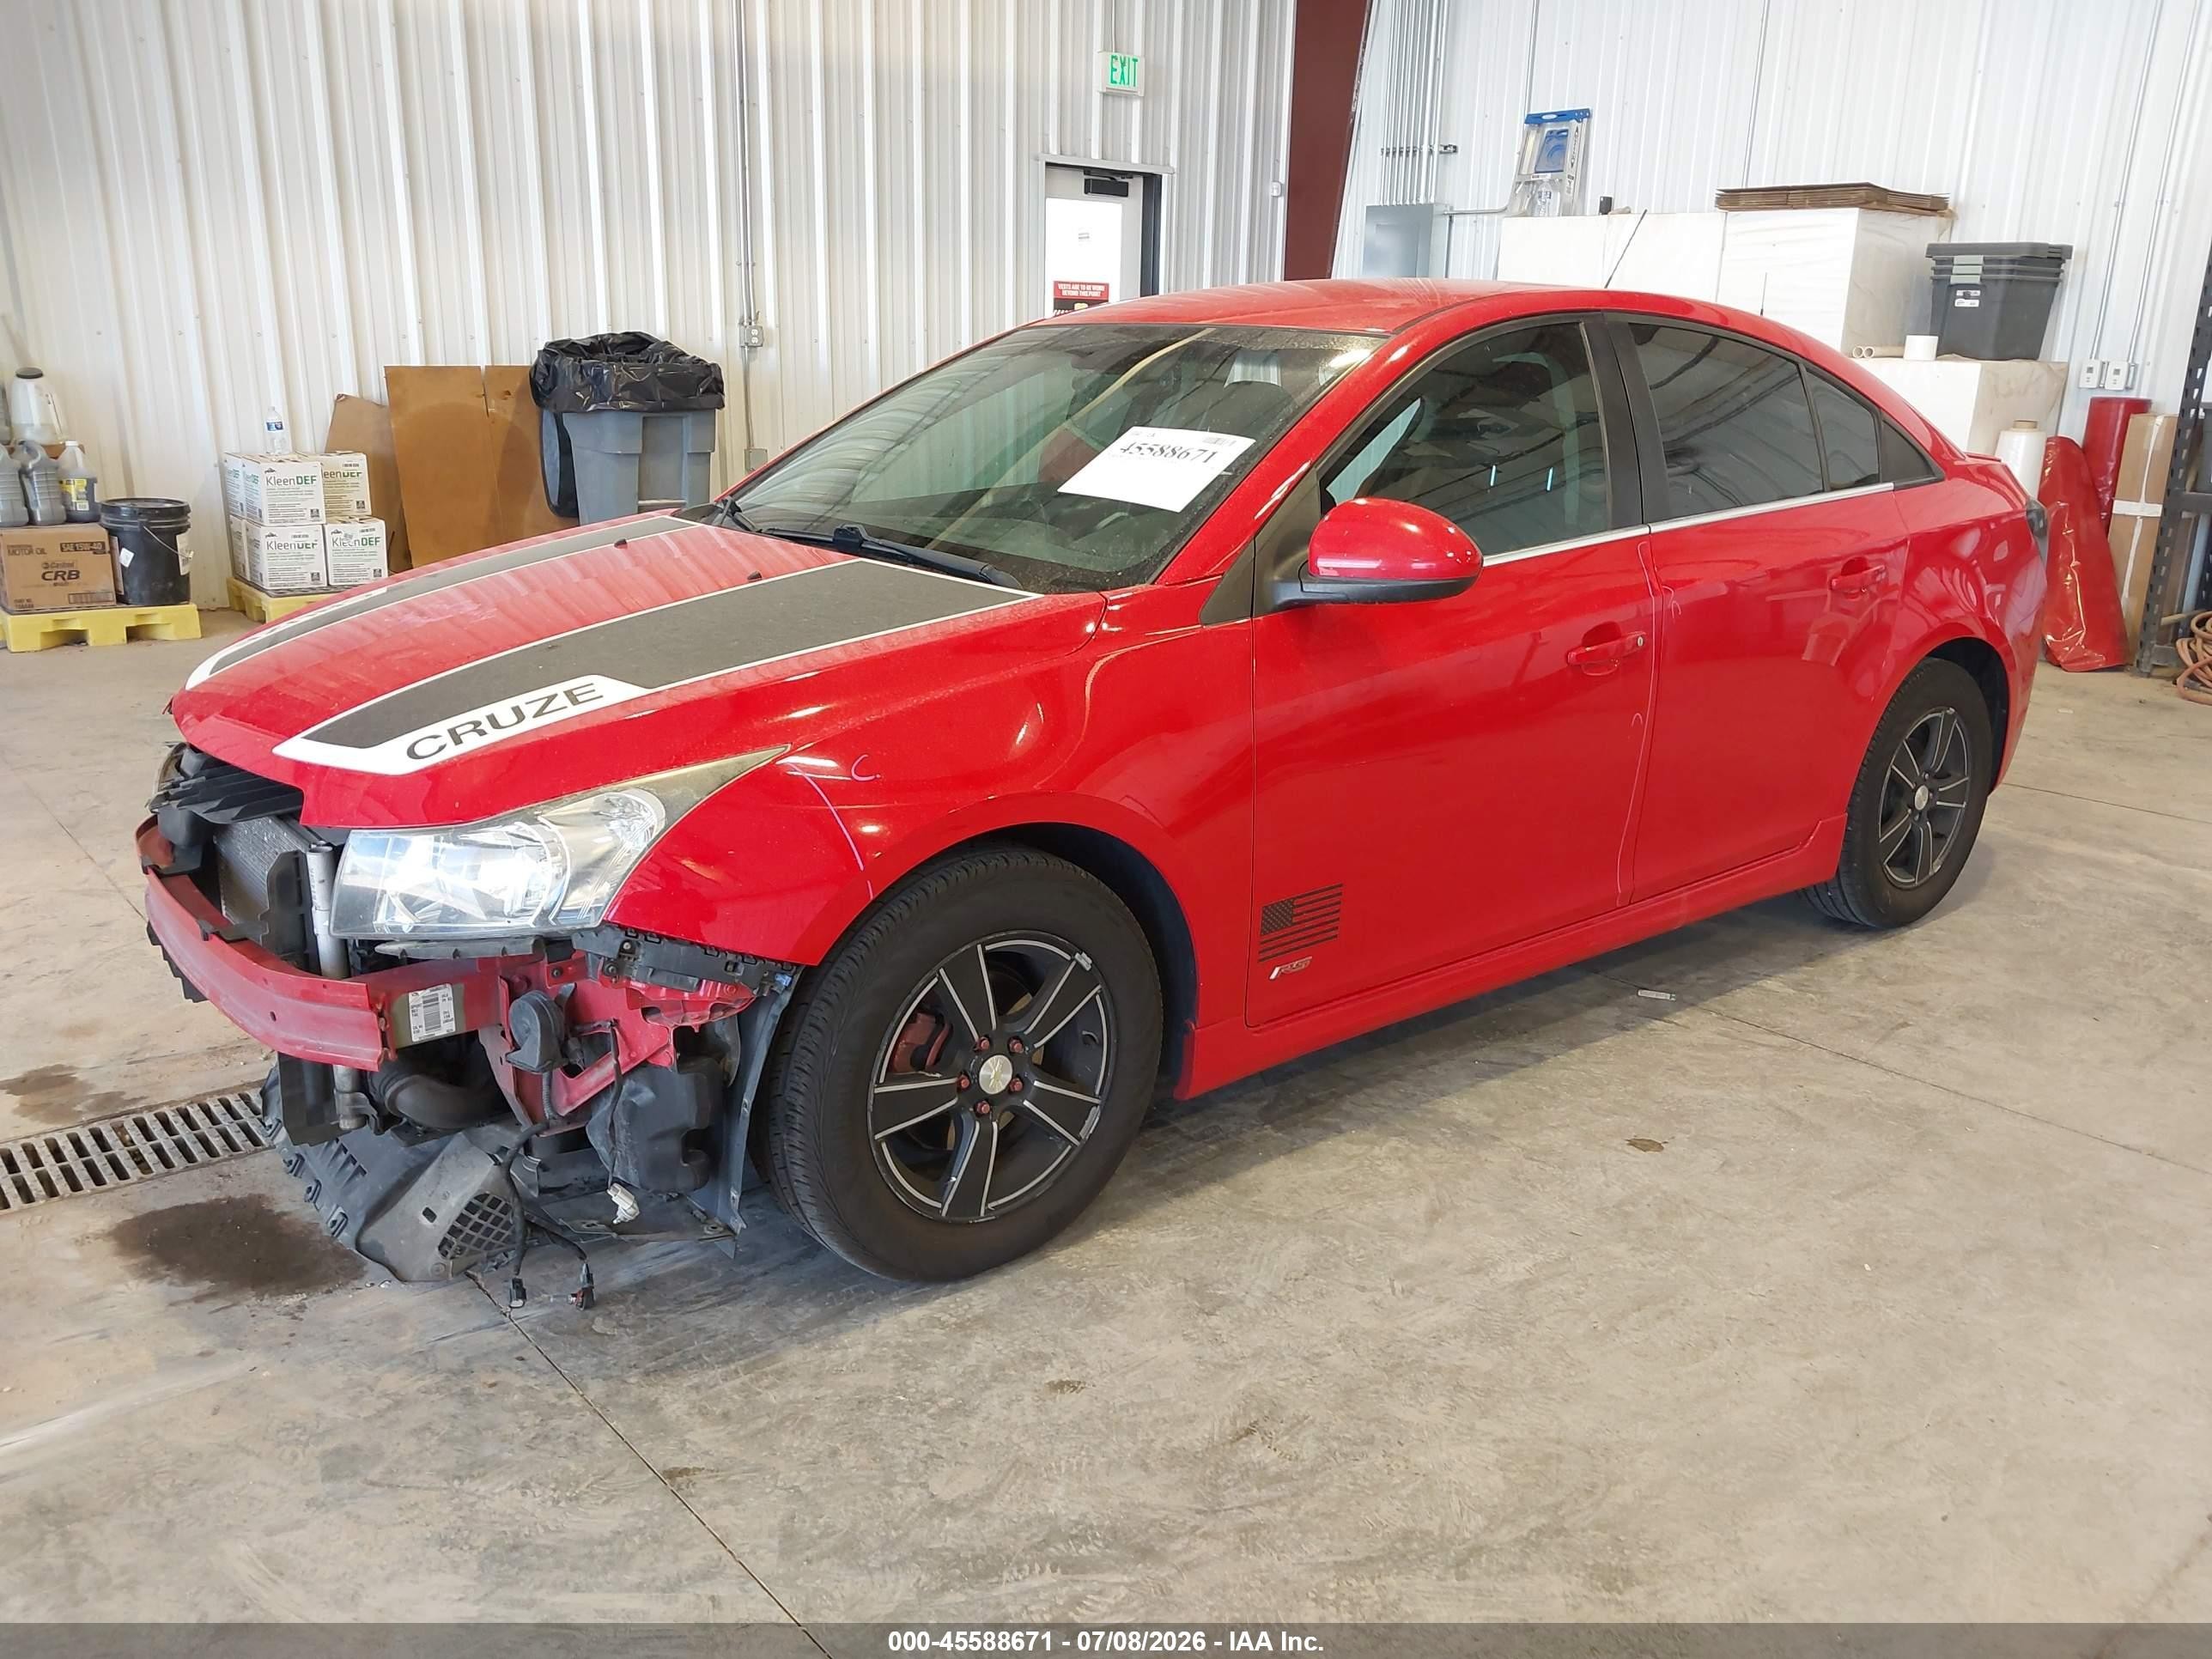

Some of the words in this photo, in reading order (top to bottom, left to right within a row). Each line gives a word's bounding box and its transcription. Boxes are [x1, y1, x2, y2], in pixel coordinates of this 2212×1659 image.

[1110, 54, 1139, 88] EXIT
[1120, 441, 1218, 464] 45588671
[265, 475, 317, 487] KleenDEF
[7, 548, 34, 556] MOTOR
[41, 569, 81, 581] CRB
[406, 683, 604, 760] CRUZE
